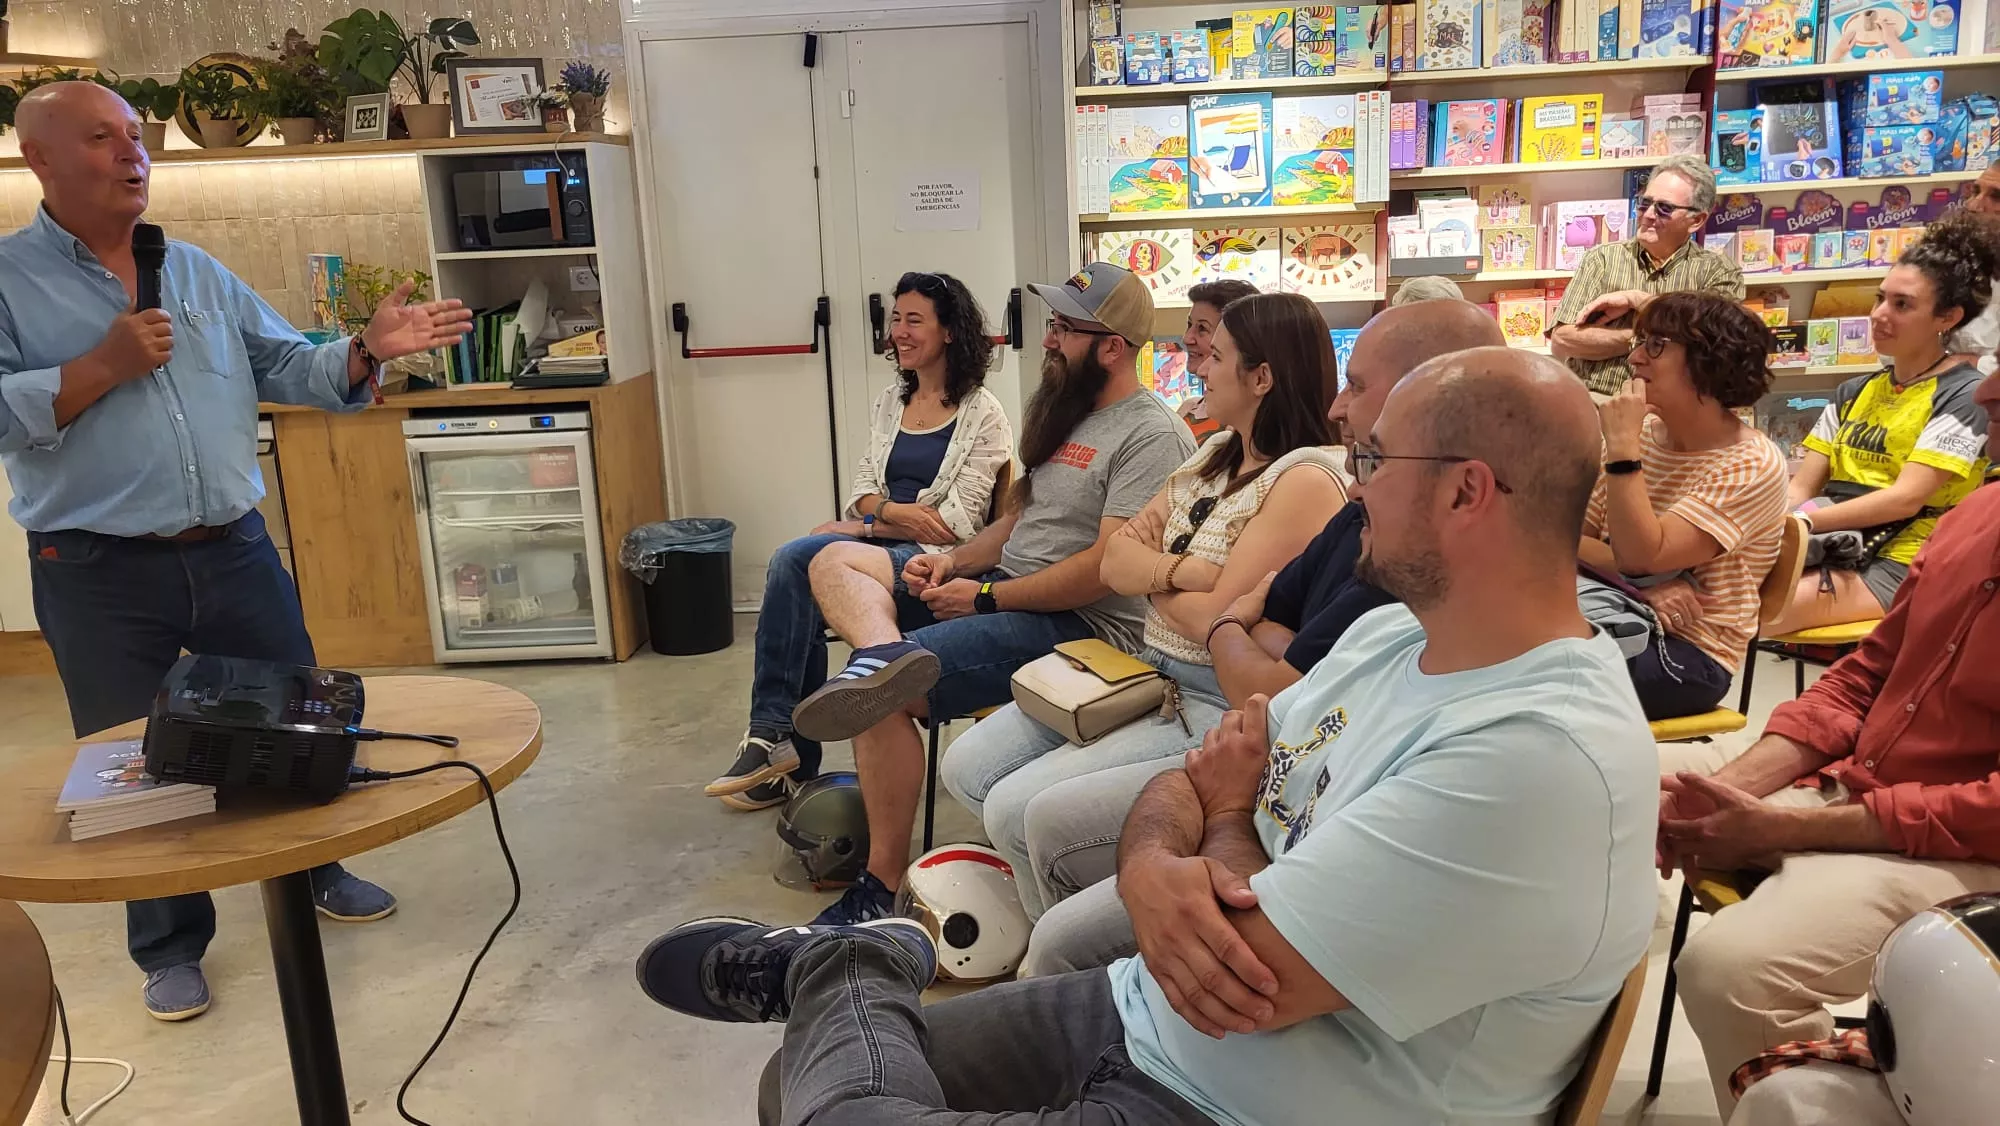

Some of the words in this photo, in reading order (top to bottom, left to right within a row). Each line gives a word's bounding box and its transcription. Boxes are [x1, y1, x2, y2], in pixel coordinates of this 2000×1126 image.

[920, 190, 954, 198] BLOQUEAR
[915, 203, 961, 212] EMERGENCIAS
[1715, 205, 1757, 225] Bloom
[1866, 205, 1918, 229] Bloom
[1787, 206, 1837, 231] Bloom
